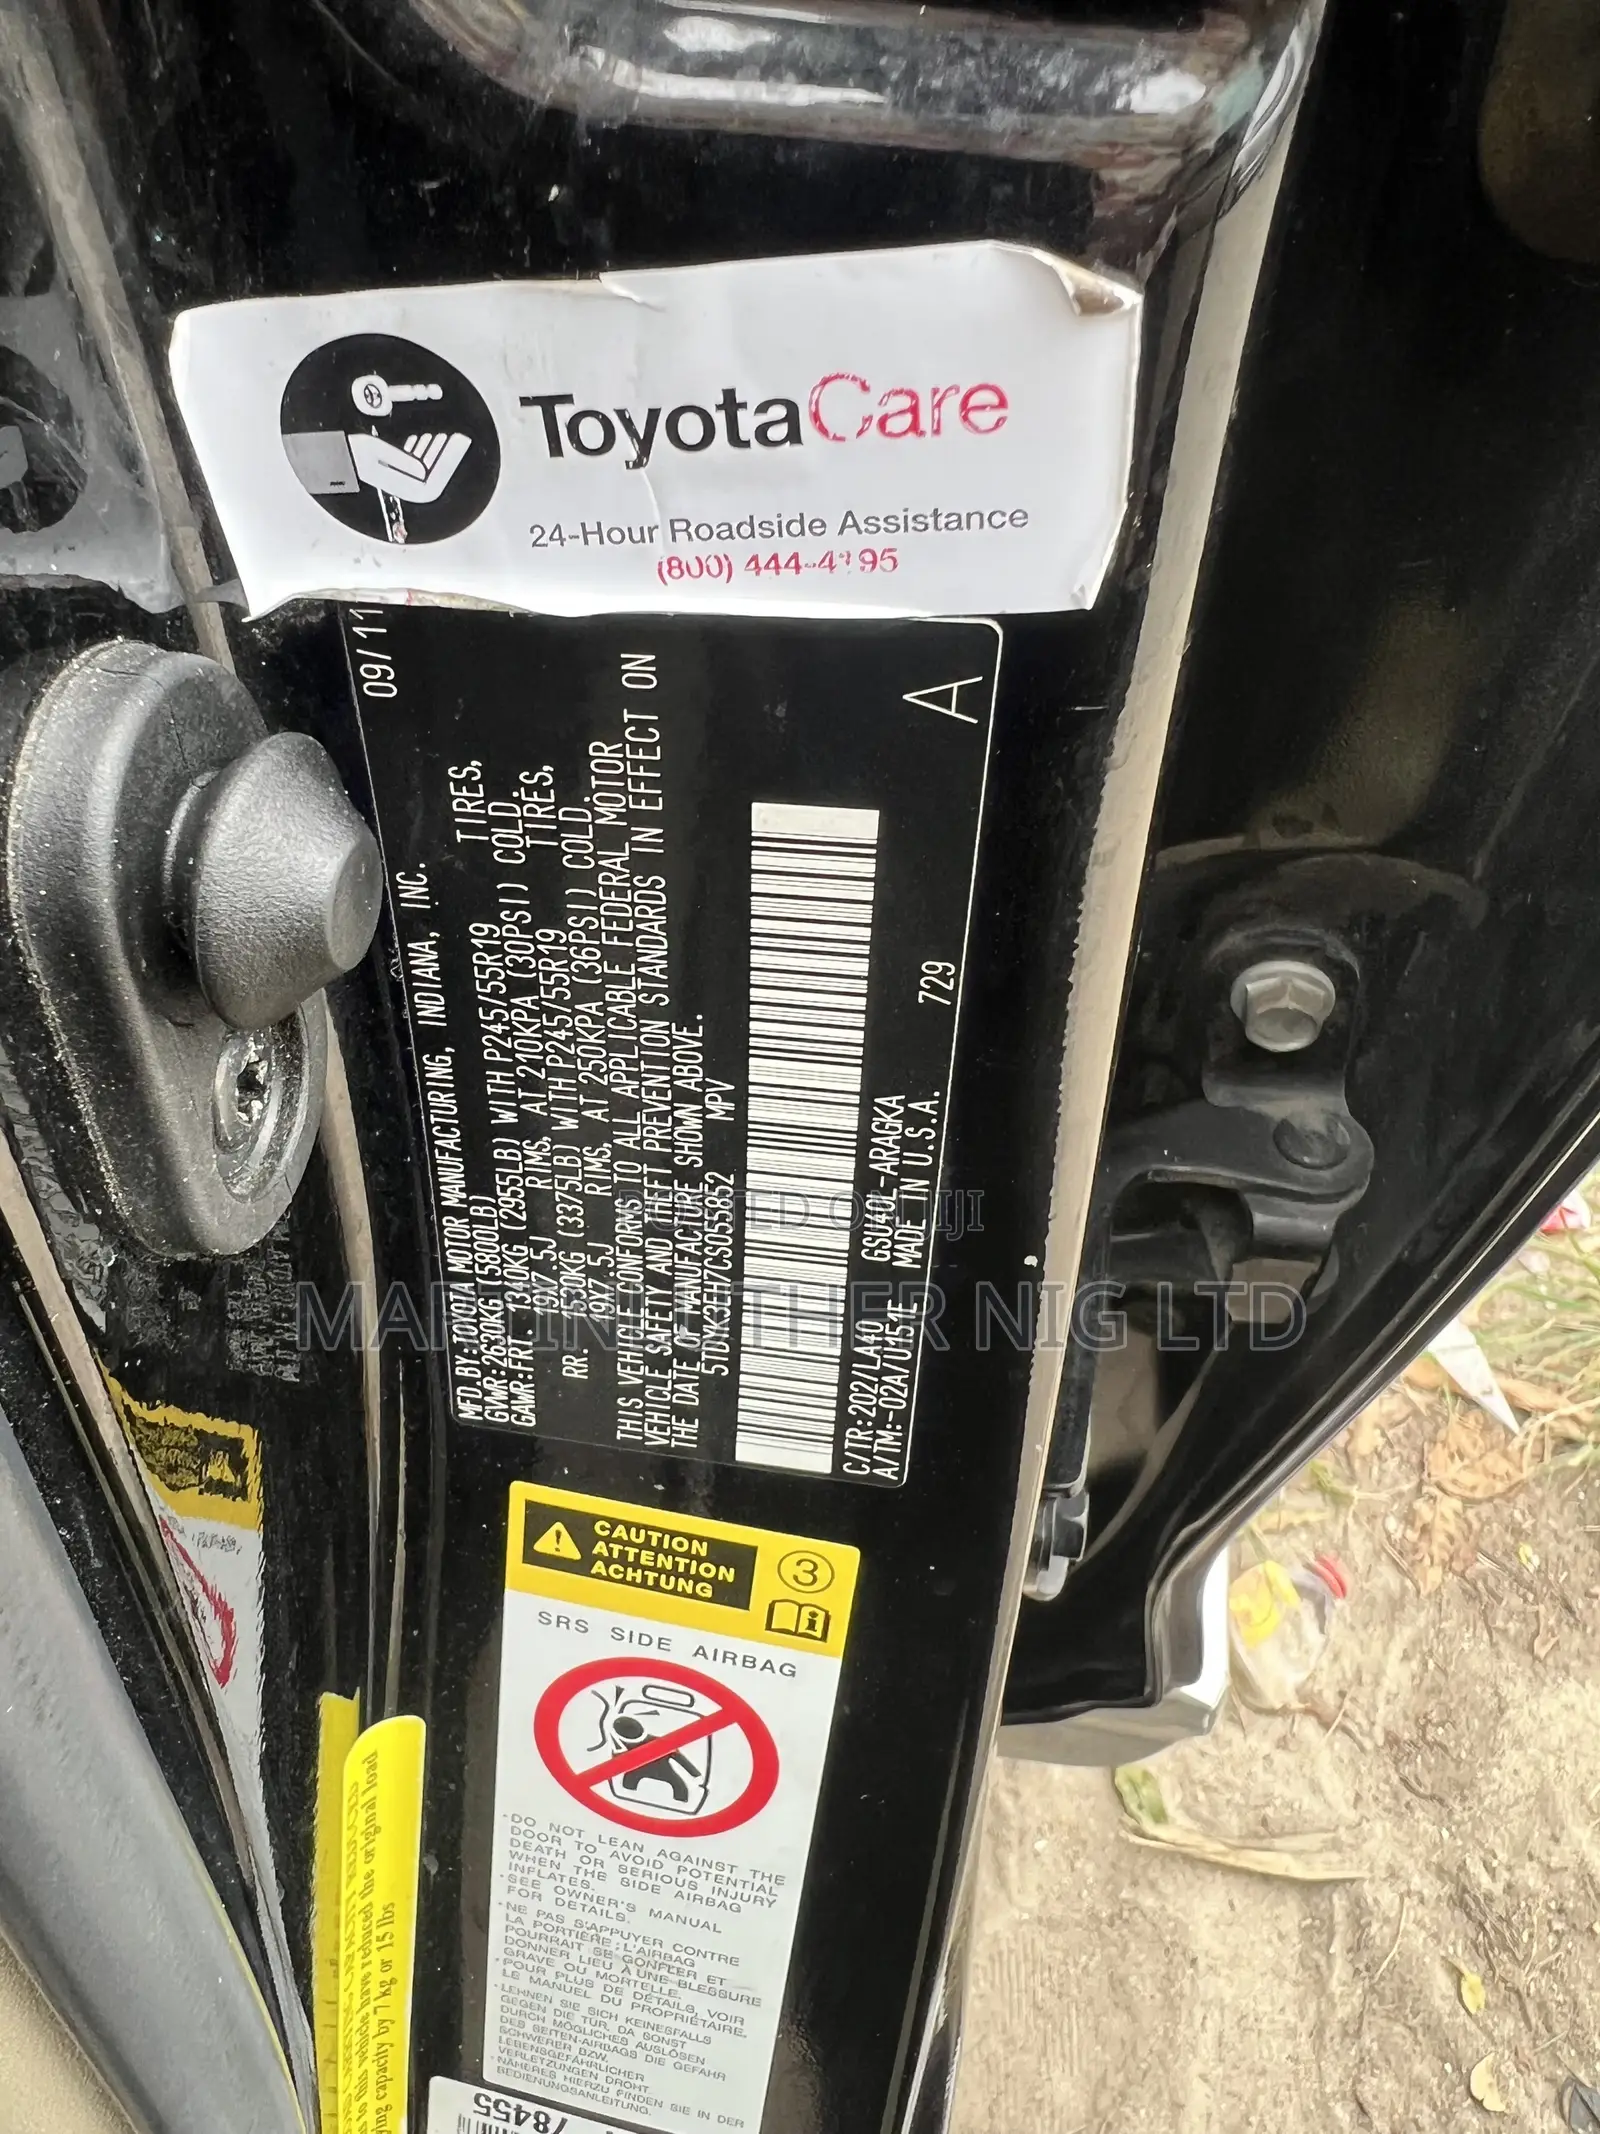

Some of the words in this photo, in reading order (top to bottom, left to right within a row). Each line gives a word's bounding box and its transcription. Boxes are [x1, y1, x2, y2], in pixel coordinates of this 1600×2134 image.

[518, 371, 1010, 470] ToyotaCare
[529, 520, 660, 549] 24-Hour
[670, 512, 828, 545] Roadside
[837, 507, 1030, 537] Assistance
[657, 553, 733, 586] (800)
[349, 608, 398, 698] 09/11
[620, 653, 658, 689] ON
[901, 675, 983, 724] A
[588, 741, 628, 826] MOTOR
[623, 708, 663, 811] EFFECT
[447, 759, 490, 843] TIRES,
[487, 791, 526, 864] COLD.
[518, 765, 559, 848] TIRES,
[557, 796, 595, 869] COLD.
[630, 826, 664, 853] IN
[395, 862, 431, 909] INC.
[596, 841, 634, 947] FEDERAL
[496, 882, 537, 978] (30PSI)
[564, 887, 603, 984] (36PSI)
[632, 875, 670, 1006] STANDARDS
[406, 931, 447, 1027] INDIANA,
[468, 922, 513, 1063] P245/55R19
[534, 928, 576, 1069] P245/55R19
[917, 960, 956, 1005] 729
[509, 994, 546, 1080] 210KPA
[573, 1000, 609, 1086] 250KPA
[603, 959, 640, 1099] APPLICABLE
[671, 1013, 703, 1093] ABOVE.
[485, 1070, 519, 1124] WITH
[517, 1087, 548, 1116] AT
[546, 1076, 579, 1131] WITH
[578, 1093, 610, 1123] AT
[638, 1019, 673, 1153] PREVENTION
[704, 1077, 735, 1121] MPV
[421, 1046, 468, 1208] MANUFACTURING,
[611, 1111, 642, 1151] ALL
[672, 1102, 703, 1168] SHOWN
[901, 1090, 940, 1167] U.S.A.
[491, 1137, 527, 1231] (2955LB)
[521, 1135, 553, 1190] RIMS,
[552, 1143, 585, 1238] (3375LB)
[581, 1142, 612, 1197] RIMS,
[612, 1160, 642, 1184] TO
[642, 1162, 673, 1224] THEFT
[860, 1094, 906, 1262] GSU40L-ARAGKA
[898, 1177, 930, 1201] IN
[441, 1215, 474, 1274] MOTOR
[468, 1194, 503, 1286] (5800LB)
[613, 1197, 644, 1294] CONFORMS
[644, 1237, 673, 1276] AND
[673, 1178, 703, 1315] MANUFACTURE
[891, 1215, 927, 1269] MADE
[500, 1242, 532, 1313] 1340KG
[528, 1235, 560, 1316] 19X7.5J
[557, 1250, 588, 1320] 1530KG
[586, 1241, 616, 1322] 19X7.5J
[615, 1303, 645, 1385] VEHICLE
[644, 1284, 673, 1356] SAFETY
[672, 1322, 701, 1348] OF
[561, 1348, 589, 1380] RR.
[671, 1357, 701, 1406] DATE
[615, 1396, 644, 1440] THIS
[643, 1364, 672, 1446] VEHICLE
[842, 1319, 884, 1475] C/TR:202/LA40
[670, 1414, 699, 1448] THE
[591, 1540, 735, 1583] ATTENTION
[593, 1519, 708, 1557] CAUTION
[590, 1559, 713, 1598] ACHTUNG
[792, 1557, 819, 1587] 3
[537, 1610, 589, 1634] SRS
[610, 1626, 672, 1652] SIDE
[691, 1644, 797, 1678] AIRBAG
[509, 1836, 566, 1860] DEATH
[578, 1854, 605, 1869] OR
[617, 1863, 698, 1891] SERIOUS
[711, 1885, 777, 1909] INJURY
[510, 1812, 537, 1828] DO
[548, 1821, 585, 1839] NOT
[597, 1833, 644, 1853] LEAN
[656, 1848, 739, 1874] AGAINST
[748, 1868, 786, 1886] THE
[510, 1824, 562, 1847] DOOR
[573, 1839, 598, 1855] TO
[608, 1849, 664, 1870] AVOID
[676, 1864, 778, 1897] POTENTIAL
[506, 1884, 542, 1902] FOR
[507, 1872, 542, 1890] SEE
[648, 1907, 722, 1934] MANUAL
[508, 1849, 561, 1871] WHEN
[572, 1864, 608, 1882] THE
[619, 1876, 661, 1895] SIDE
[673, 1889, 742, 1914] AIRBAG
[374, 1930, 395, 1952] 15
[375, 1901, 396, 1930] lbs
[504, 1912, 525, 1926] LA
[505, 1900, 528, 1915] NE
[535, 1908, 565, 1925] PAS
[671, 1942, 740, 1967] CONTRE
[372, 1976, 399, 2002] kg
[378, 1957, 394, 1973] or
[563, 1961, 587, 1975] OU
[706, 1974, 727, 1986] ET
[371, 2017, 396, 2040] by
[372, 2004, 391, 2016] 7
[599, 1993, 623, 2007] DU
[602, 1983, 624, 1997] DE
[706, 2008, 745, 2027] VOIR
[370, 2041, 396, 2101] capacity
